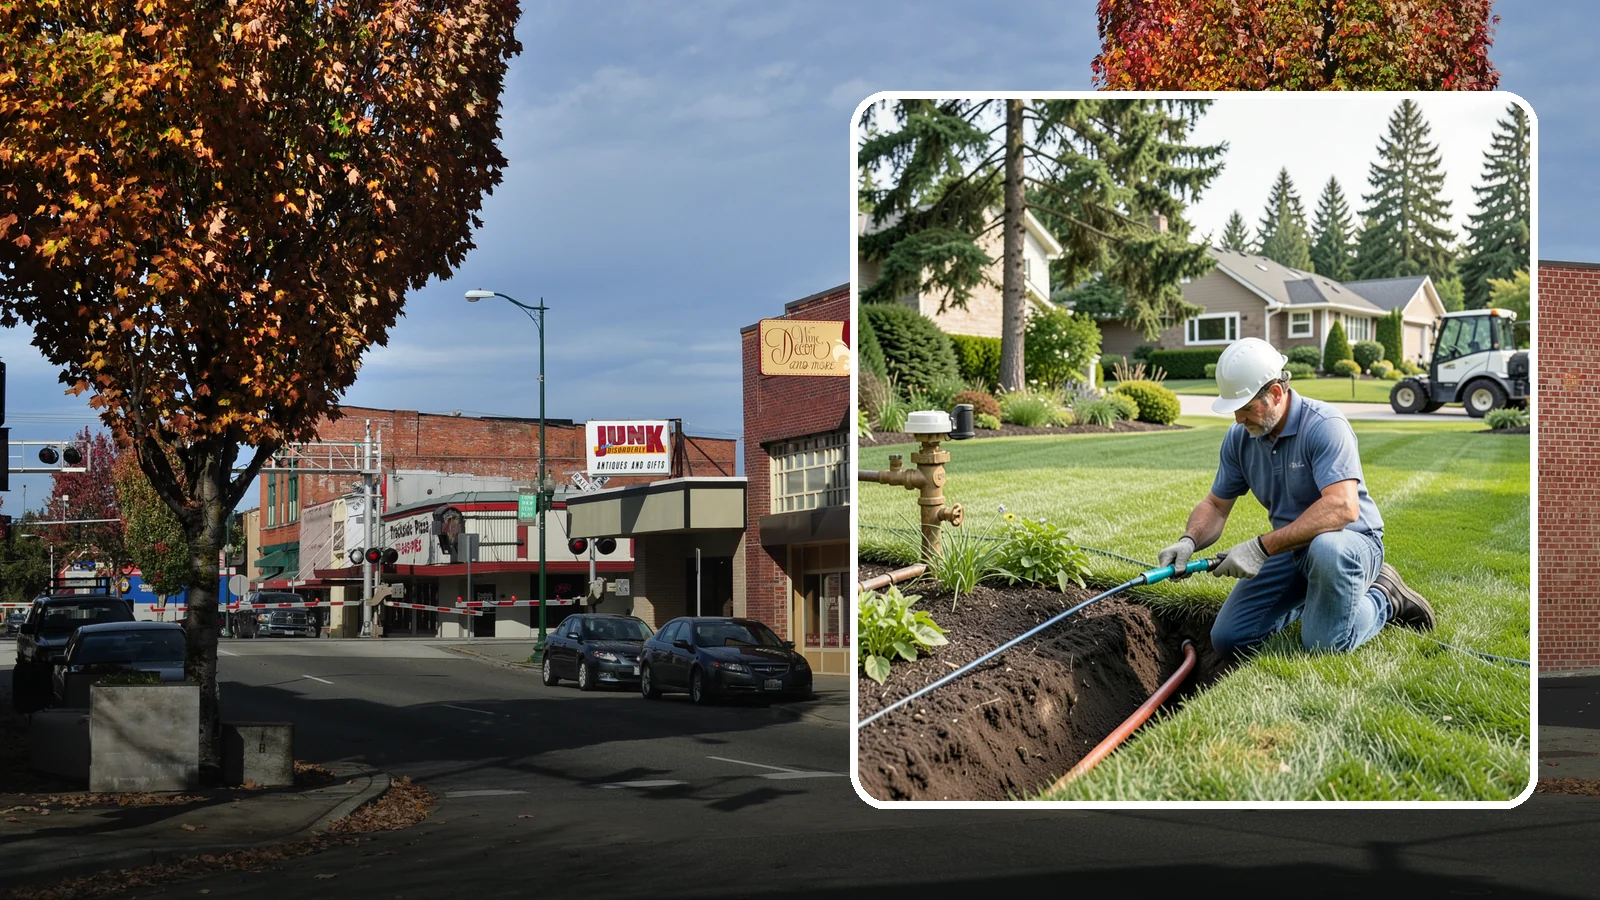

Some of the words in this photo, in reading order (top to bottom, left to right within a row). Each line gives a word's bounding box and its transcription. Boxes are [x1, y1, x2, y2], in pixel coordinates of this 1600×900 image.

[791, 325, 823, 345] Wine
[765, 327, 831, 365] Decor
[595, 425, 664, 457] JUNK
[597, 461, 628, 470] ANTIQUES
[631, 461, 644, 469] AND
[647, 460, 665, 469] GIFTS
[390, 521, 413, 540] Trackside
[415, 520, 429, 535] Pizza
